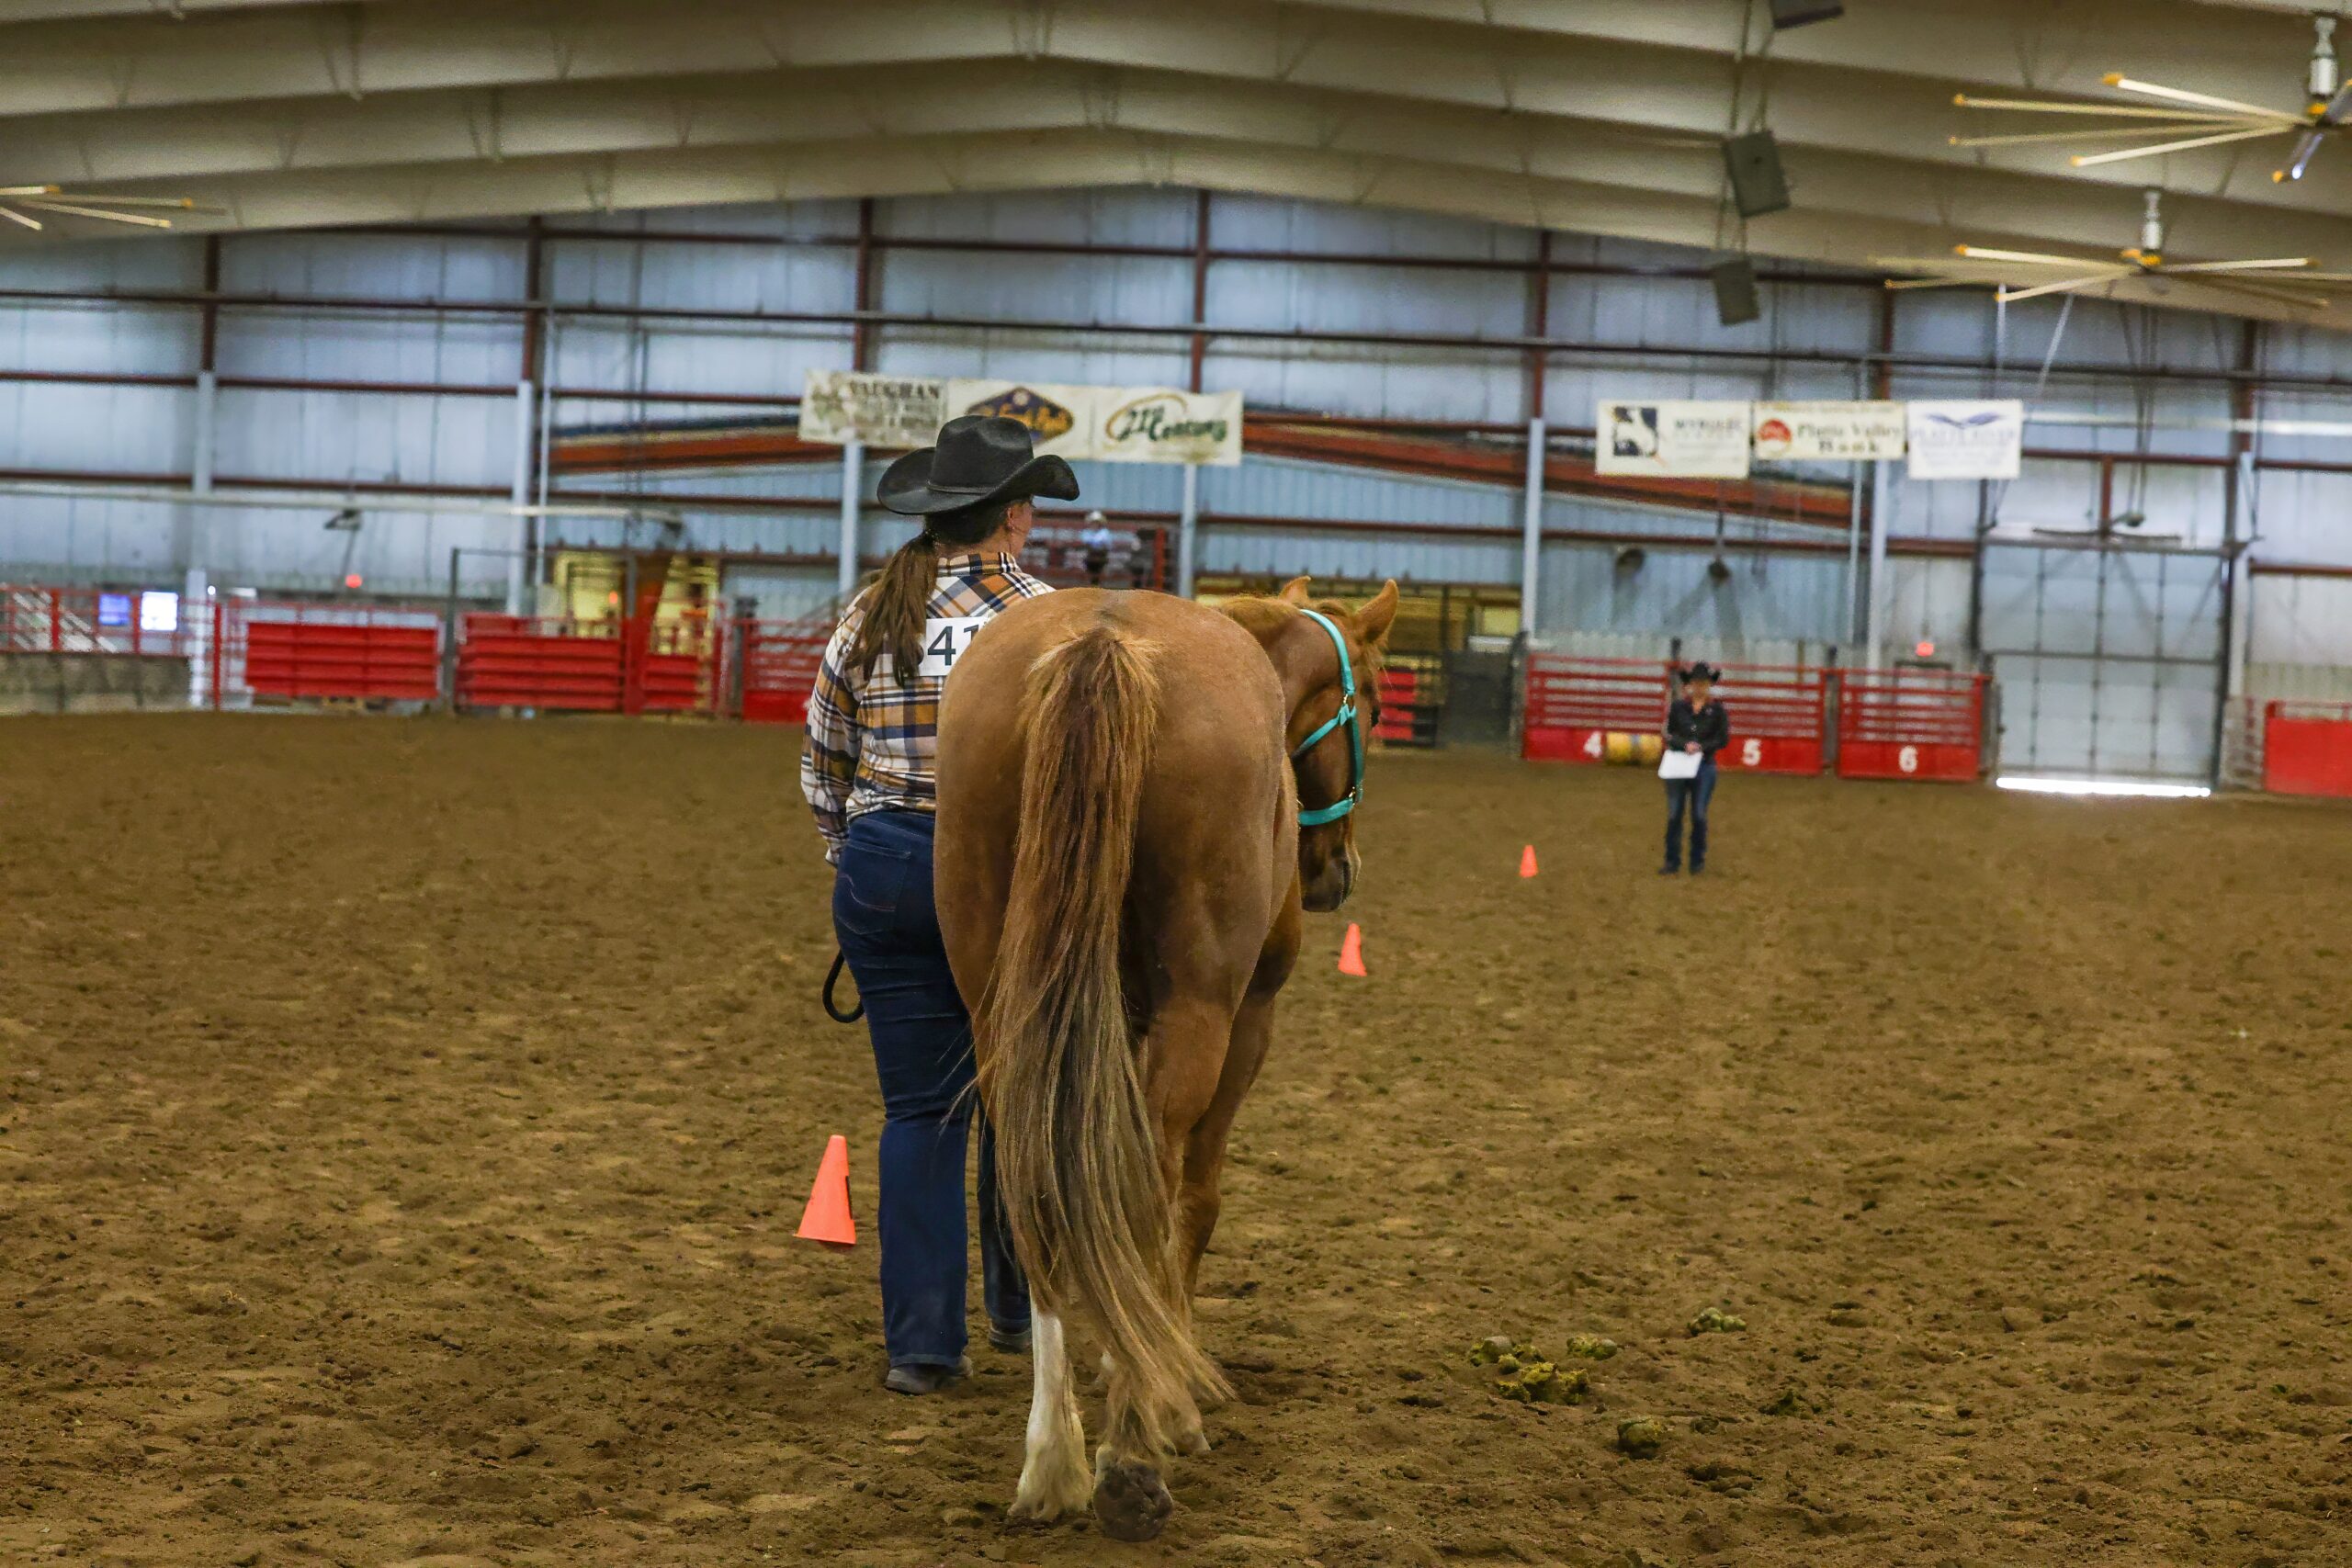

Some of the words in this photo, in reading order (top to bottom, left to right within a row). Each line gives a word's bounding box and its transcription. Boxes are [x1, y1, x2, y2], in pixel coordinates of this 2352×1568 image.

[1583, 731, 1602, 759] 4
[1742, 739, 1762, 766] 5
[1898, 745, 1918, 773] 6
